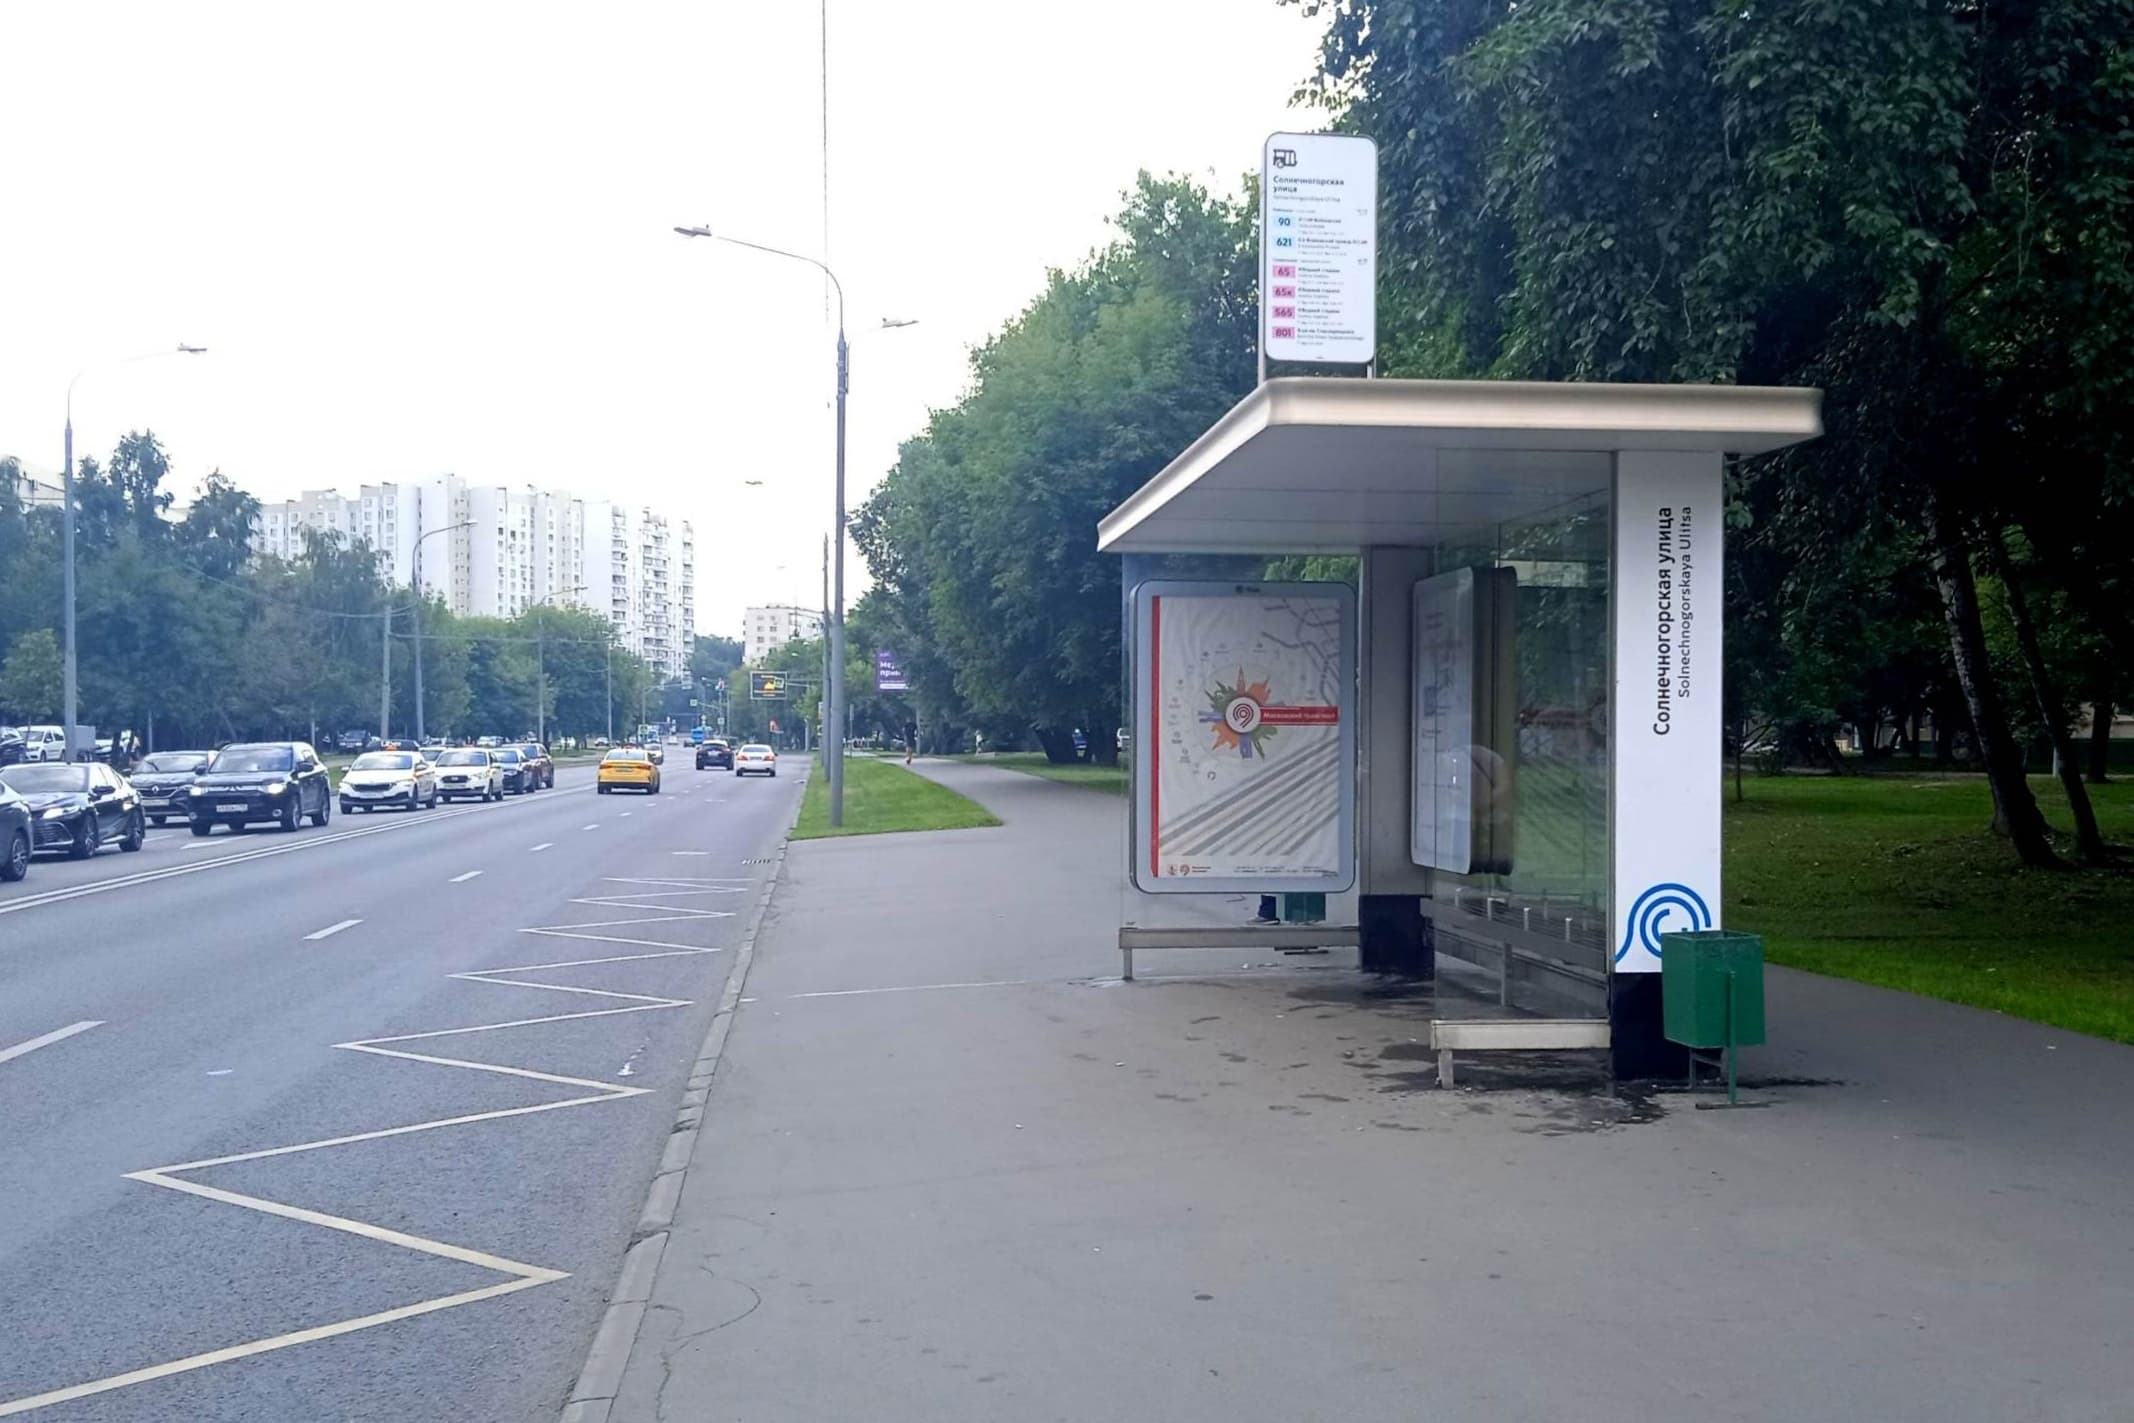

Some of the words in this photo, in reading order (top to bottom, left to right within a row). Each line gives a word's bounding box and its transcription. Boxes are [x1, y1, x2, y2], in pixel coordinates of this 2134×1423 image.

[1273, 175, 1345, 186] Солнечногорская
[1278, 217, 1291, 227] 90
[1276, 238, 1292, 247] 621
[1277, 267, 1291, 276] 65
[1658, 507, 1676, 564] улица
[1678, 506, 1692, 550] Ulitsa
[1677, 554, 1694, 698] Solnechnogorskaya
[1653, 569, 1675, 736] Солнечногорская
